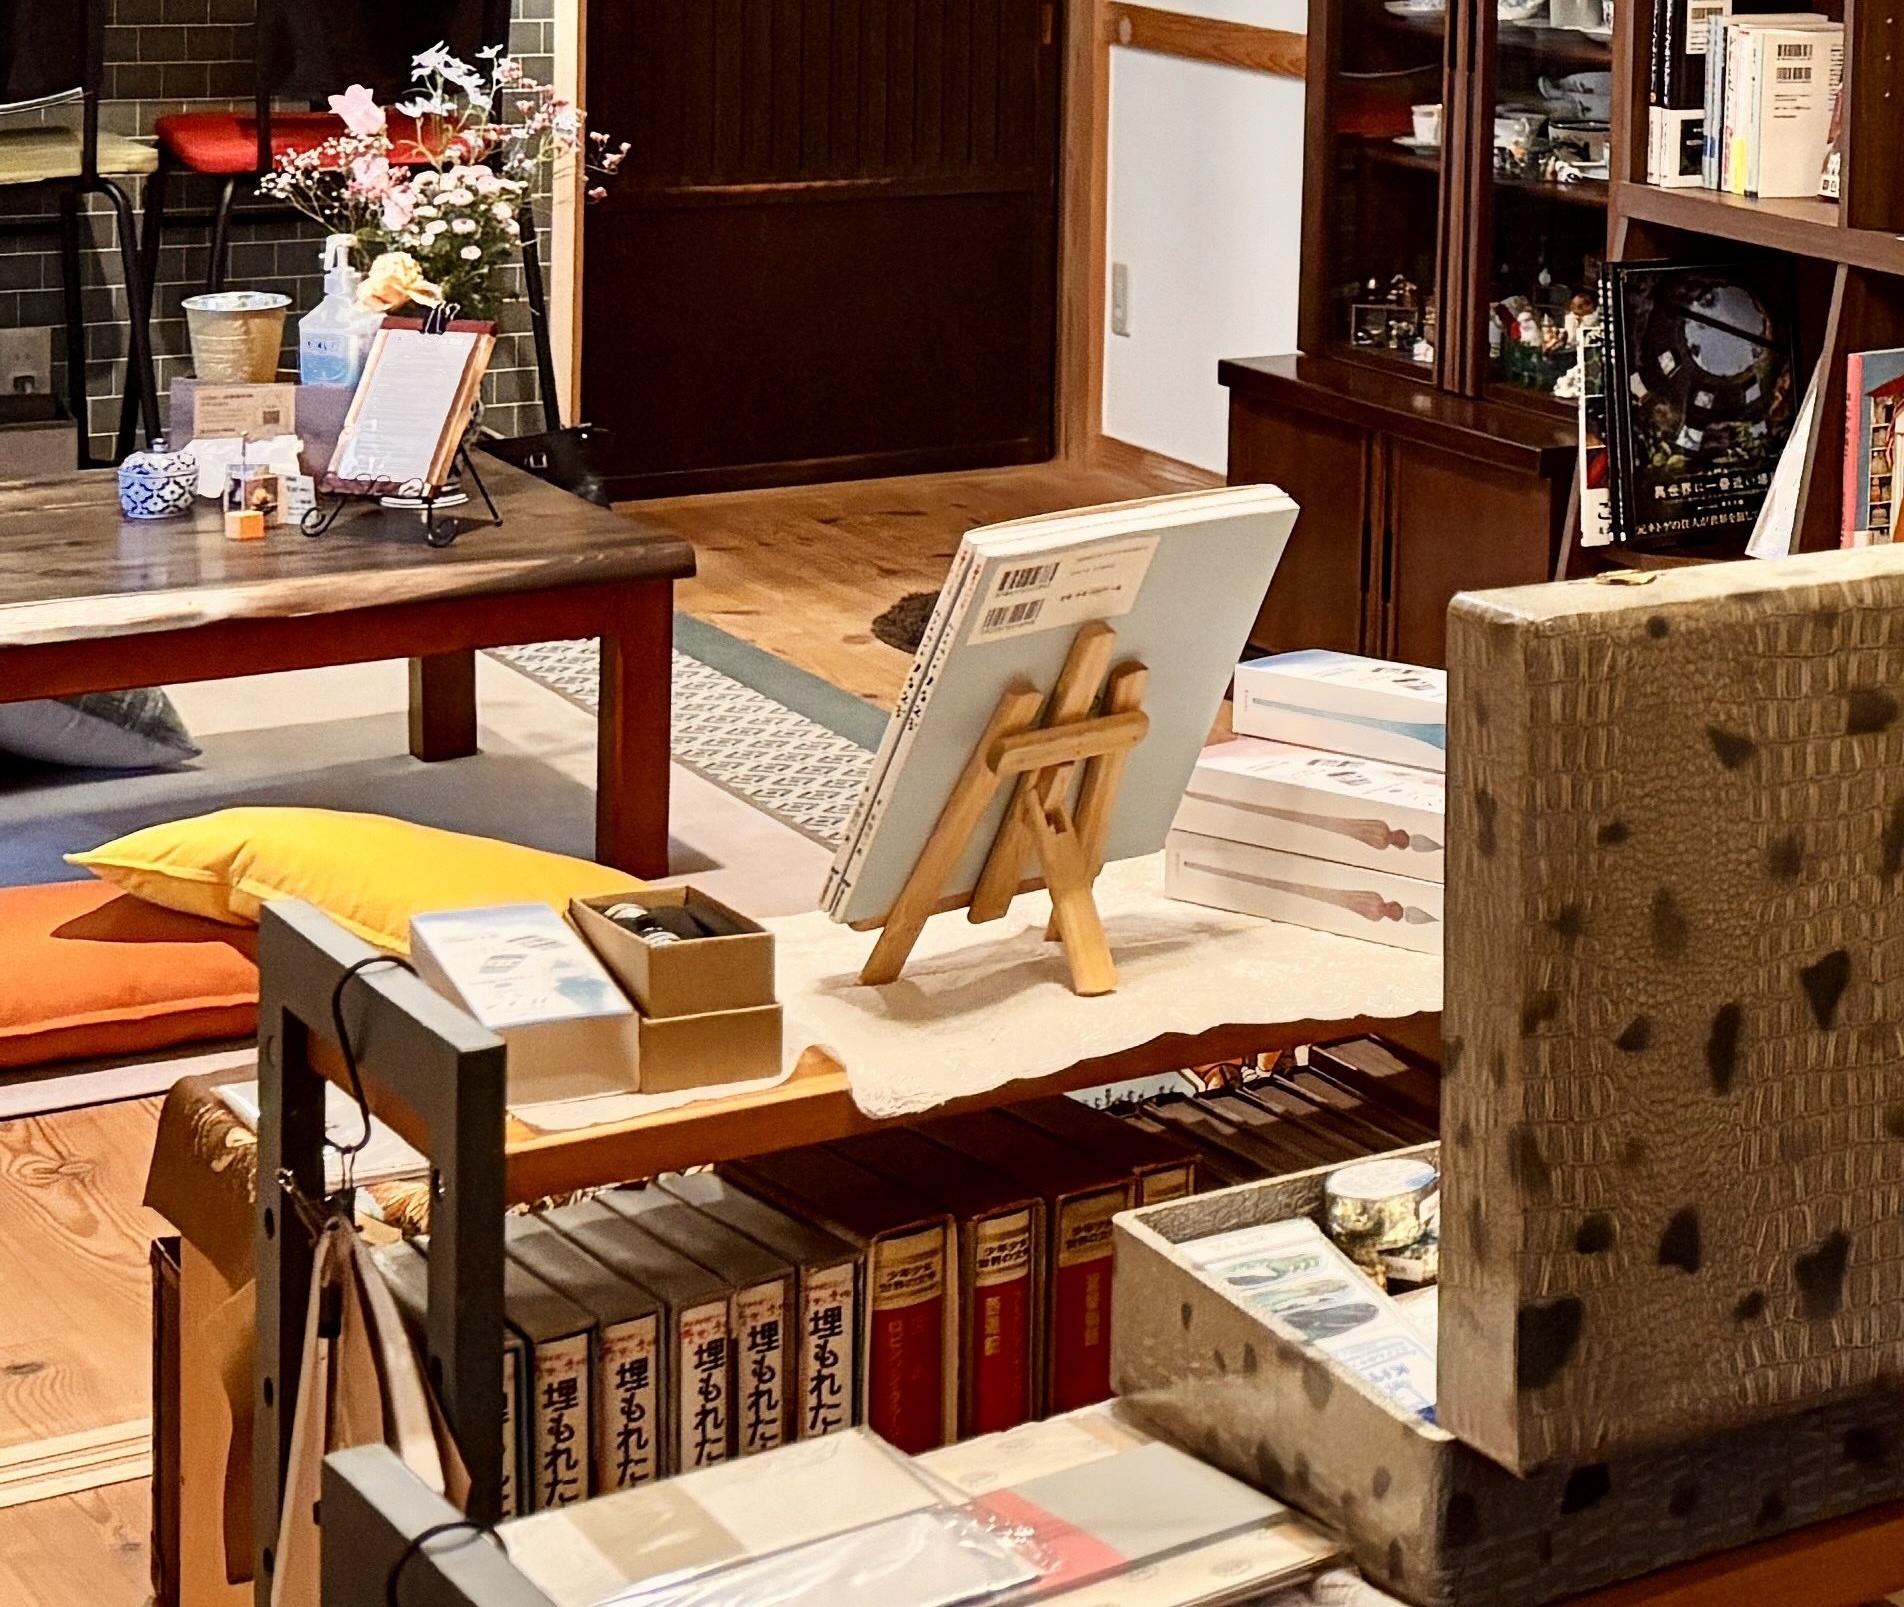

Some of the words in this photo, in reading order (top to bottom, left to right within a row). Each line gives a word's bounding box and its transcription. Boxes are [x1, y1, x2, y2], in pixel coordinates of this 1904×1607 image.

[615, 1356, 650, 1487] 埋もれた
[694, 1337, 726, 1467] 埋もれた
[747, 1320, 780, 1444] 埋もれた
[809, 1305, 844, 1435] 埋もれた
[542, 1378, 580, 1509] 埋もれた
